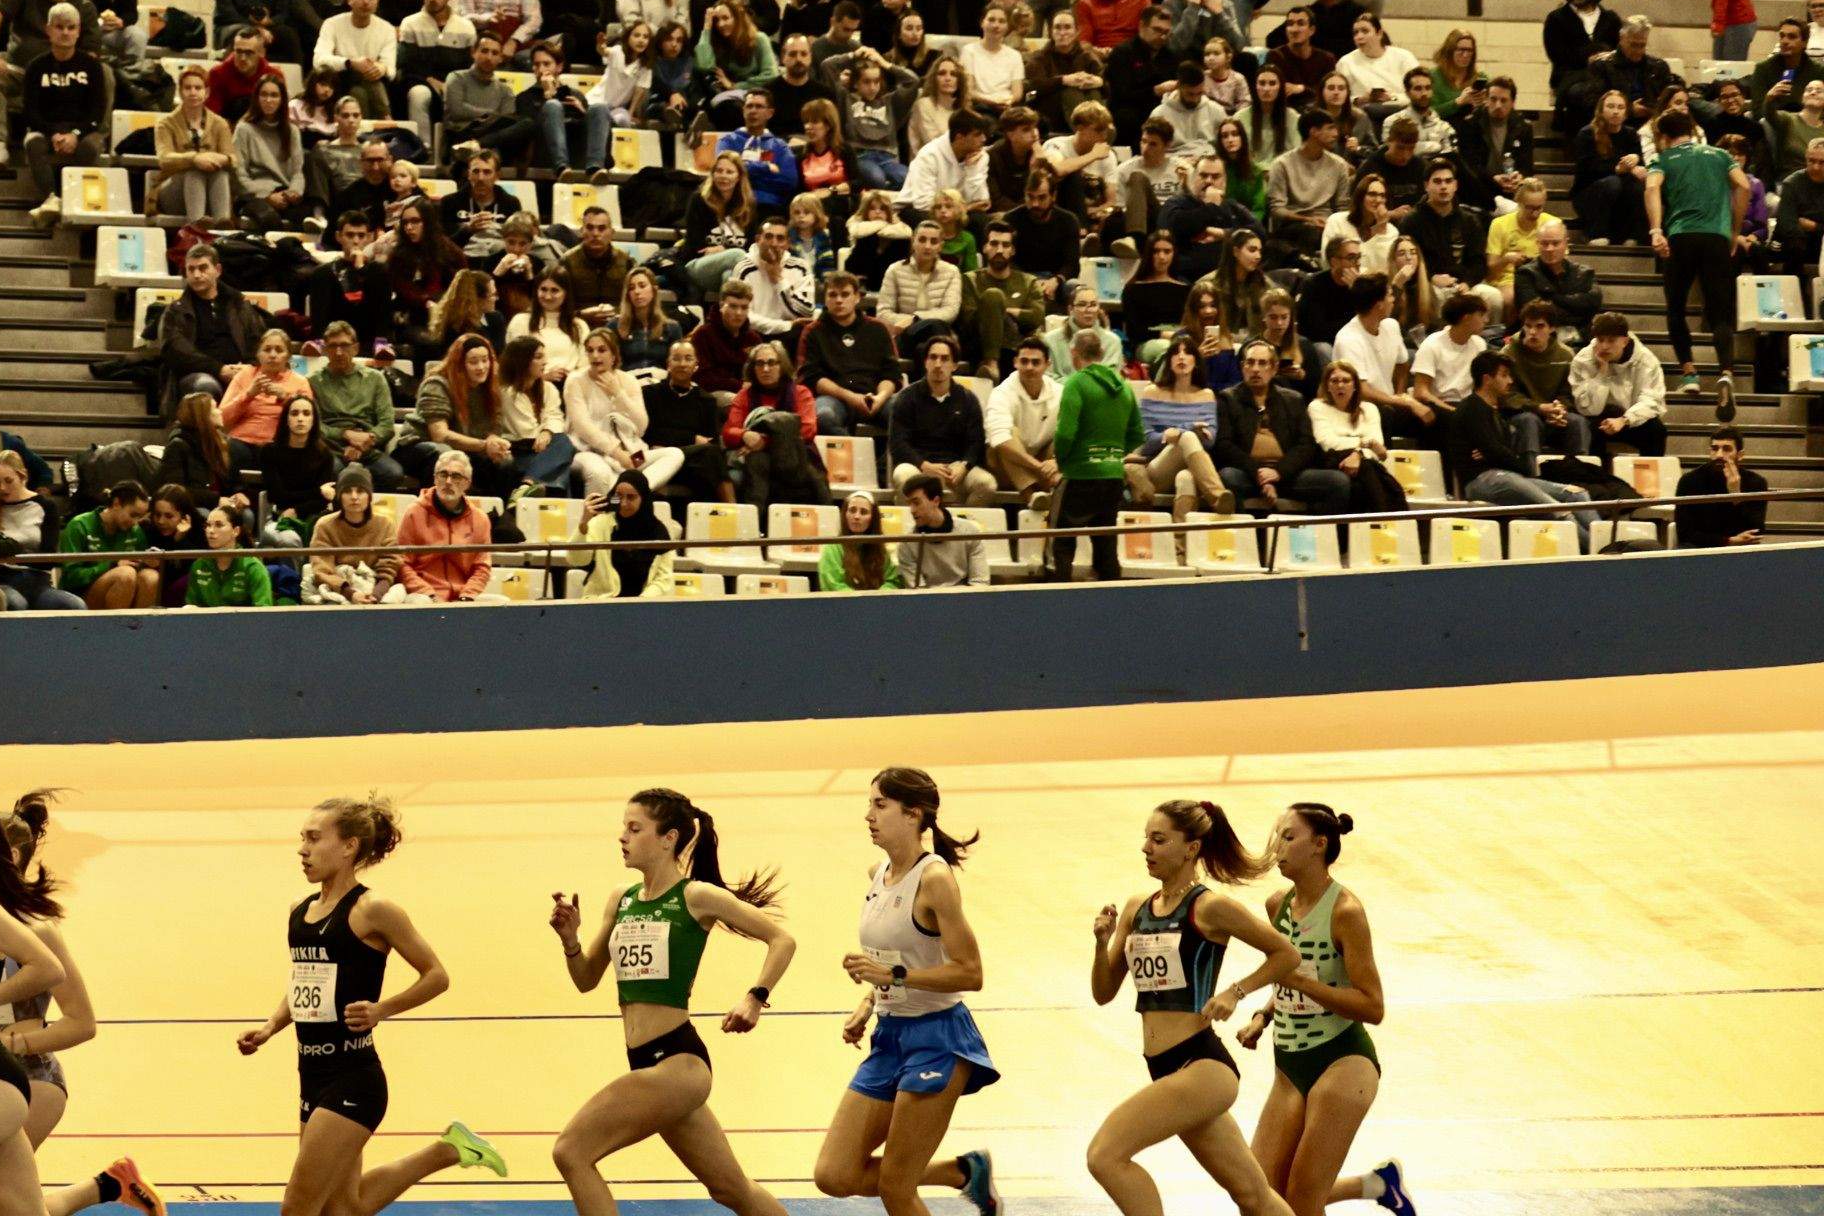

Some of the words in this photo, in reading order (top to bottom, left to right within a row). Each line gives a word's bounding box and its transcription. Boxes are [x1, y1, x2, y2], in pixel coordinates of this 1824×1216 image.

[40, 71, 89, 88] ASICS
[618, 944, 653, 968] 255
[1133, 955, 1168, 979] 209
[293, 985, 322, 1008] 236
